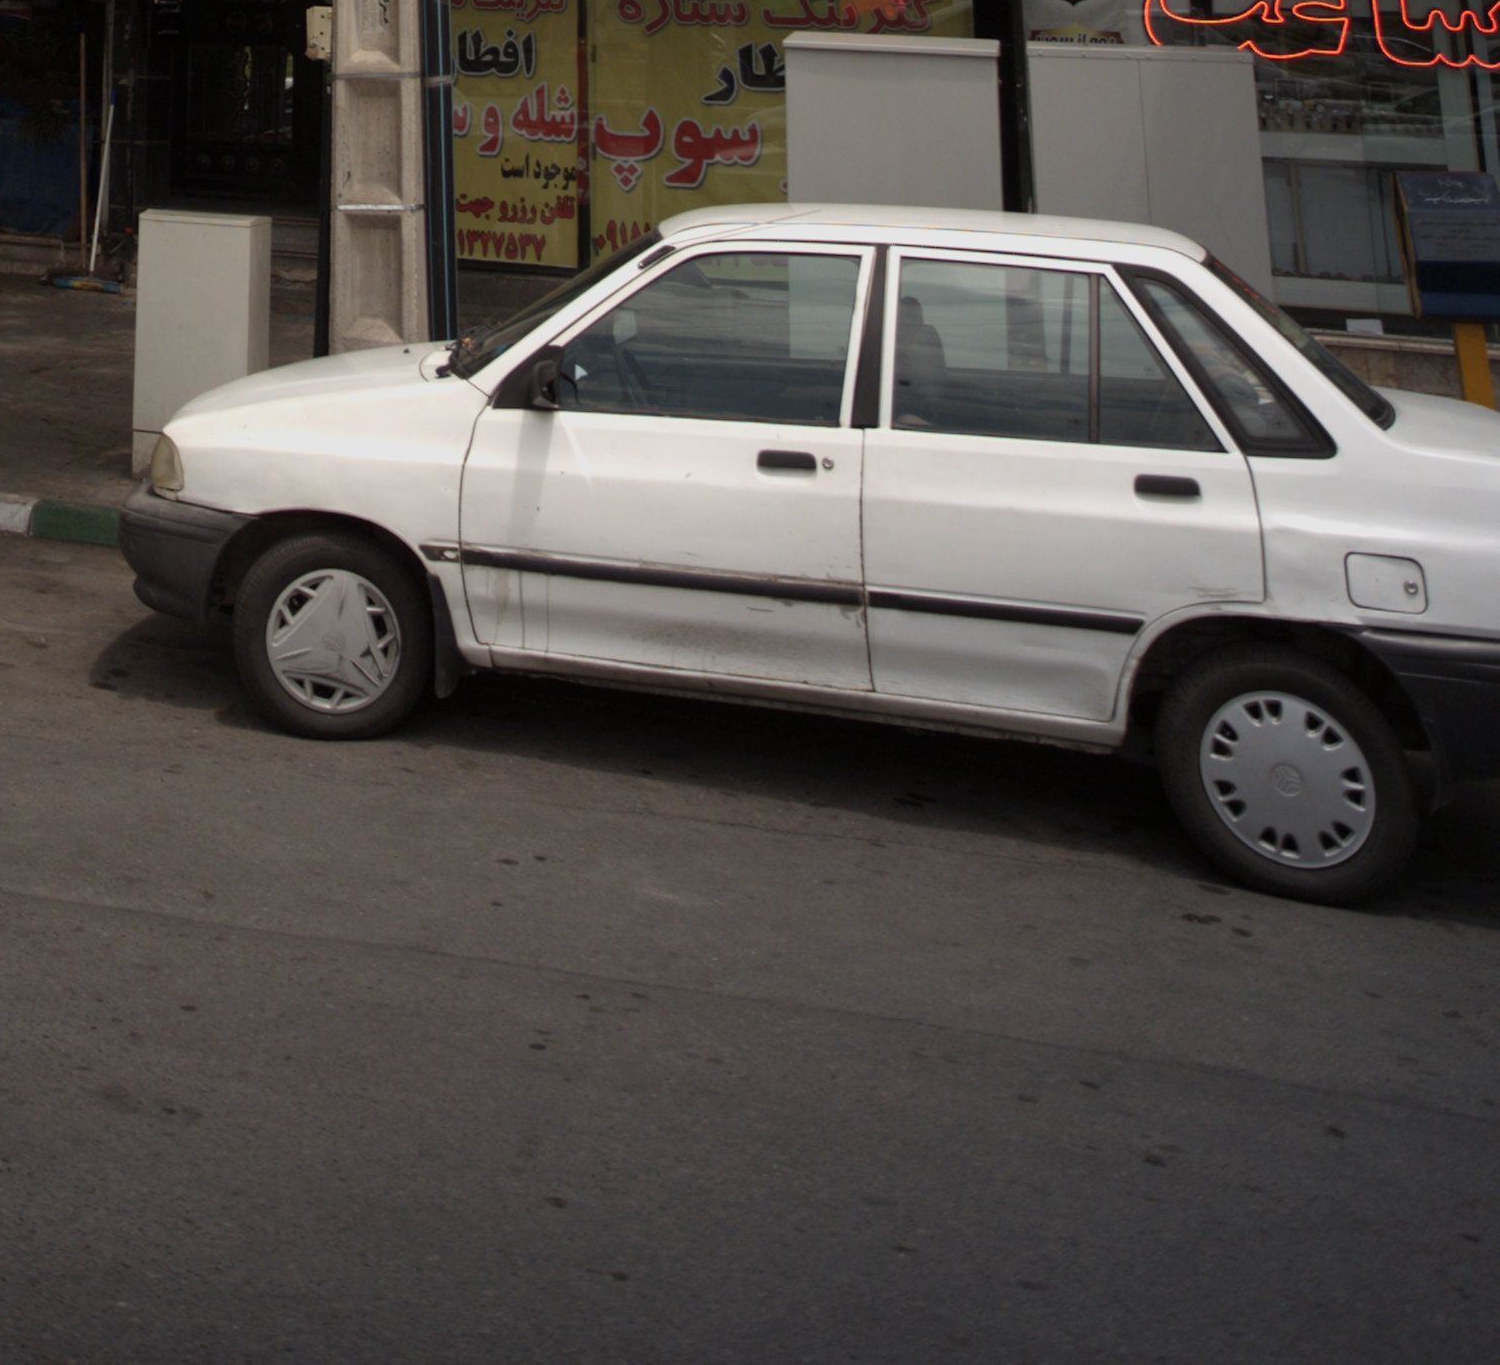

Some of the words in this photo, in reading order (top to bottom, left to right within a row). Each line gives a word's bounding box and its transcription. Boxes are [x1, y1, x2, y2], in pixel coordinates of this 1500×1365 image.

[451, 28, 537, 84] افطا
[701, 42, 787, 105] طار
[476, 103, 503, 156] و
[510, 81, 578, 142] شله
[500, 152, 530, 179] است
[533, 159, 578, 190] موجود
[593, 106, 762, 191] سوپ
[455, 193, 495, 220] جهت
[497, 196, 538, 225] رزرو
